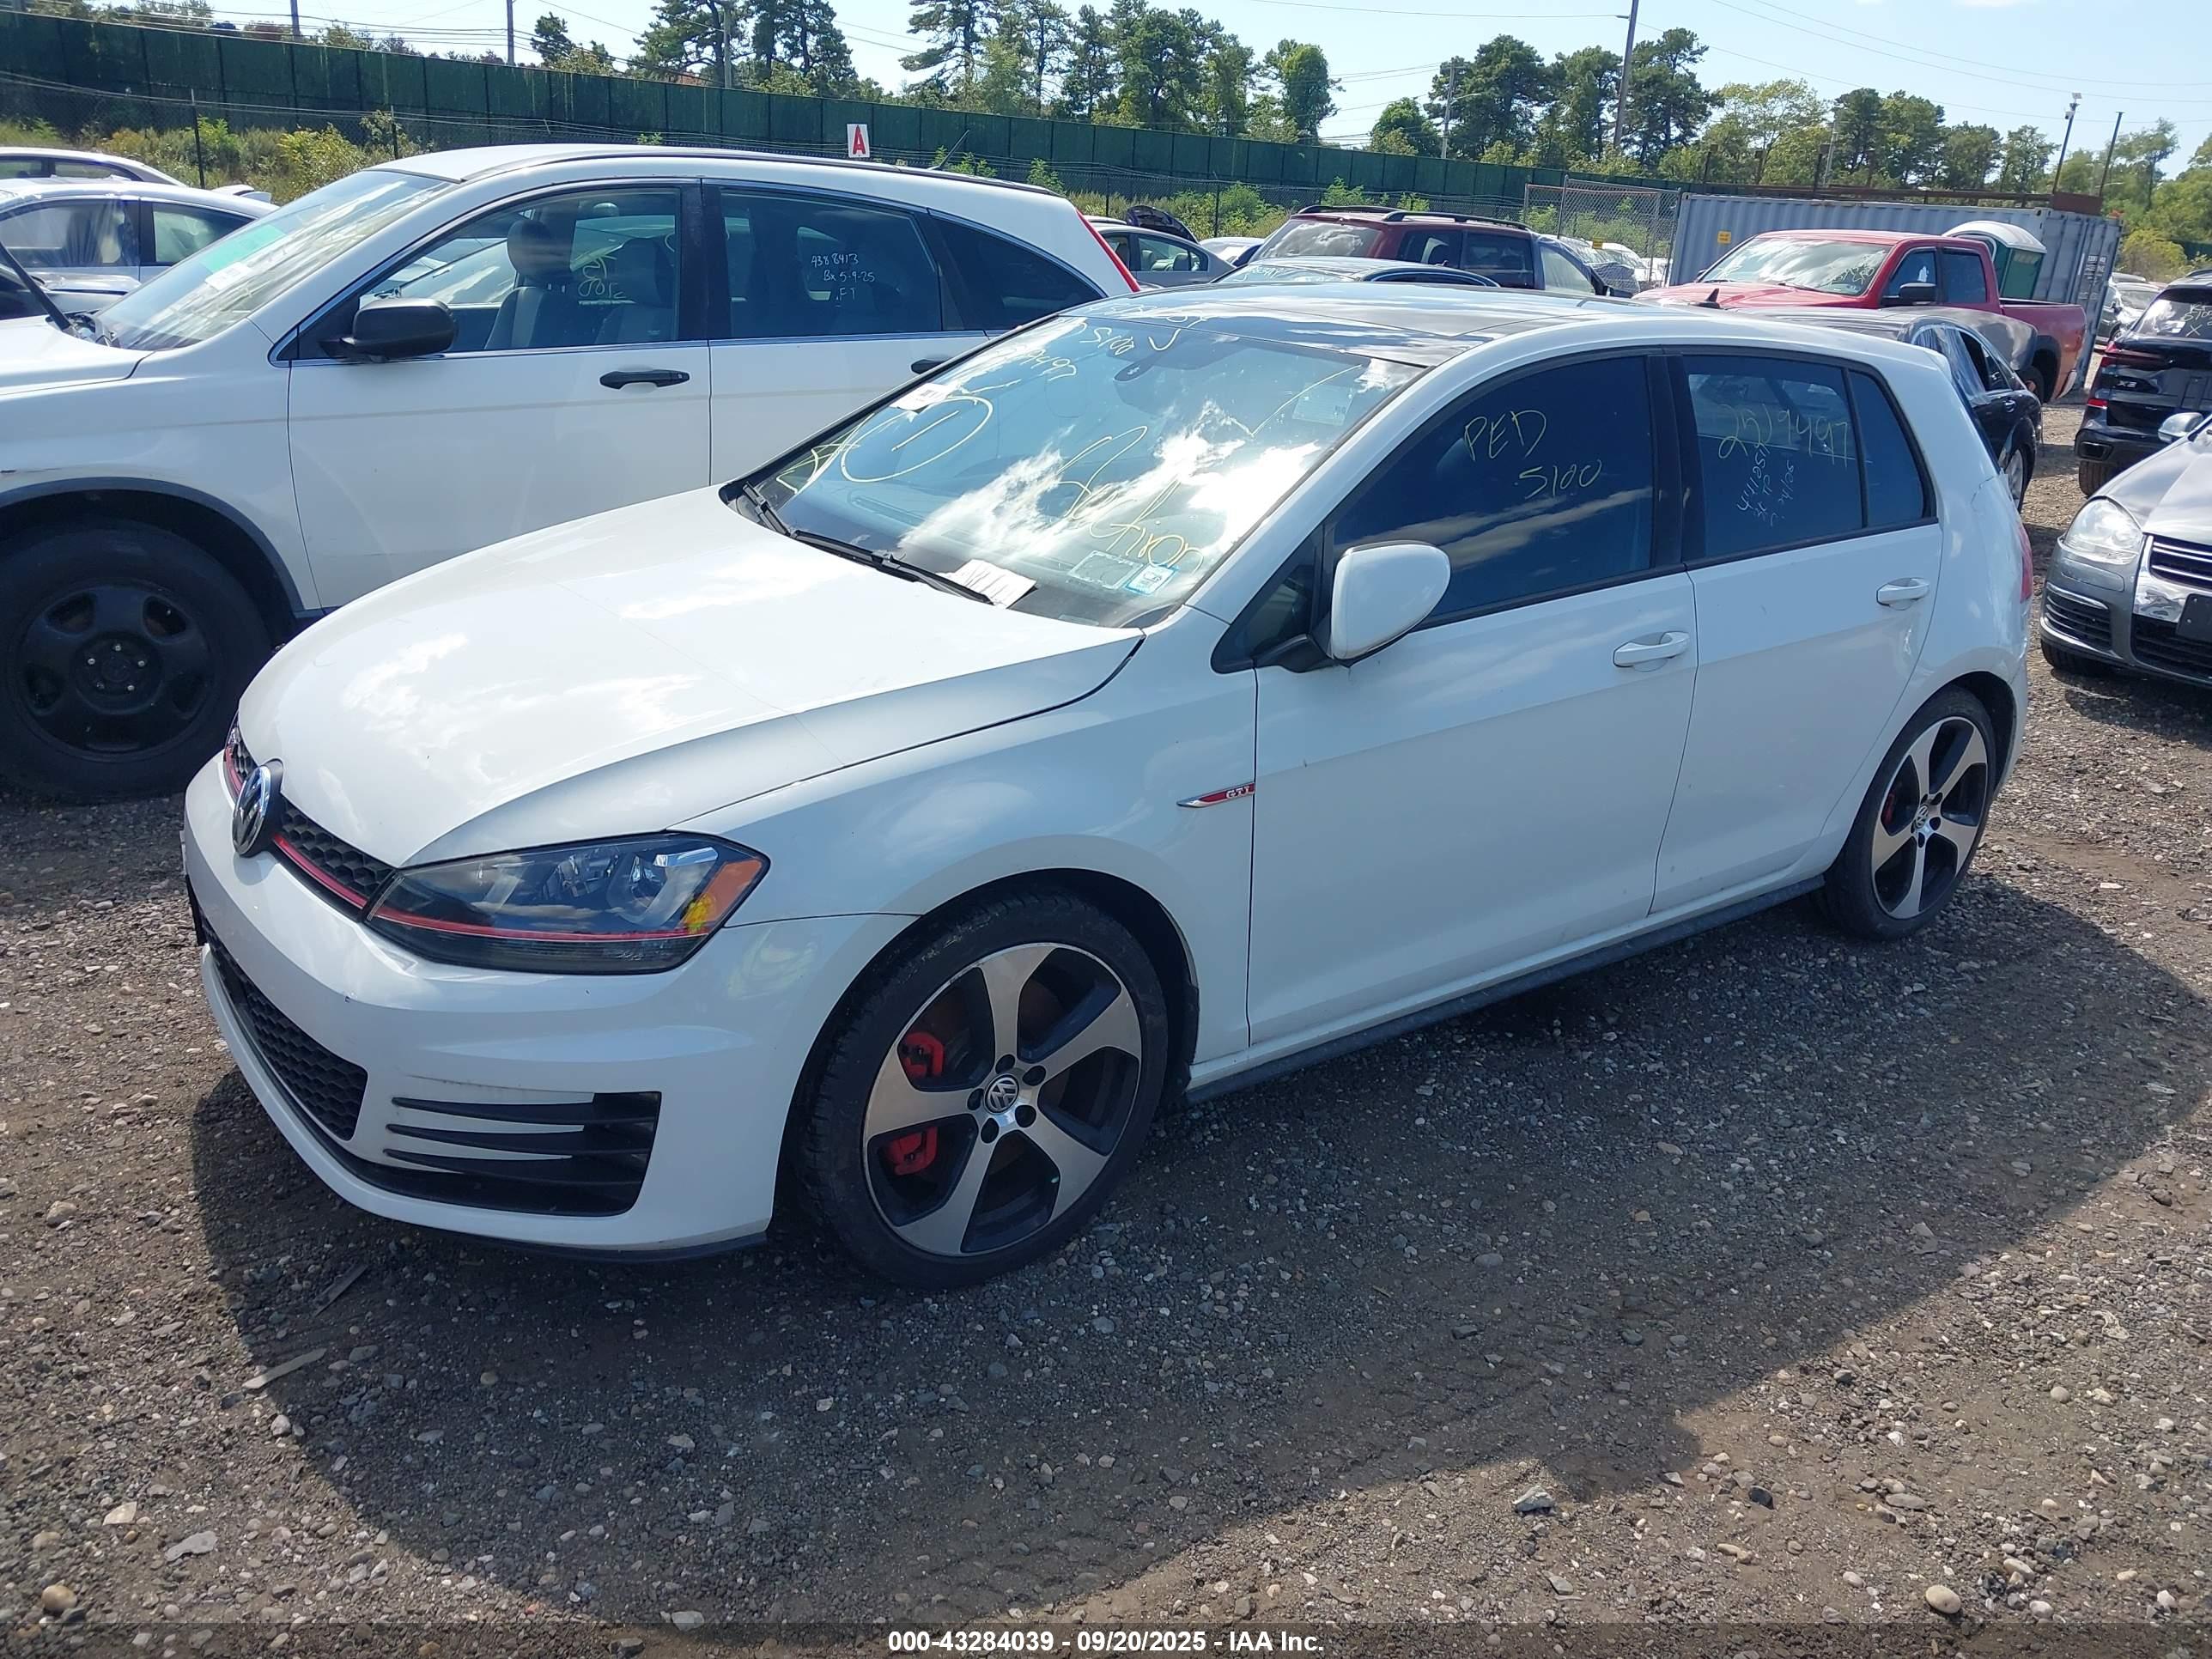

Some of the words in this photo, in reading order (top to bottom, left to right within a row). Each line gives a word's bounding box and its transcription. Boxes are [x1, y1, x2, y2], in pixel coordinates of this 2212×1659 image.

[853, 125, 866, 155] A
[1464, 410, 1547, 461] PED
[1225, 785, 1250, 799] GTI
